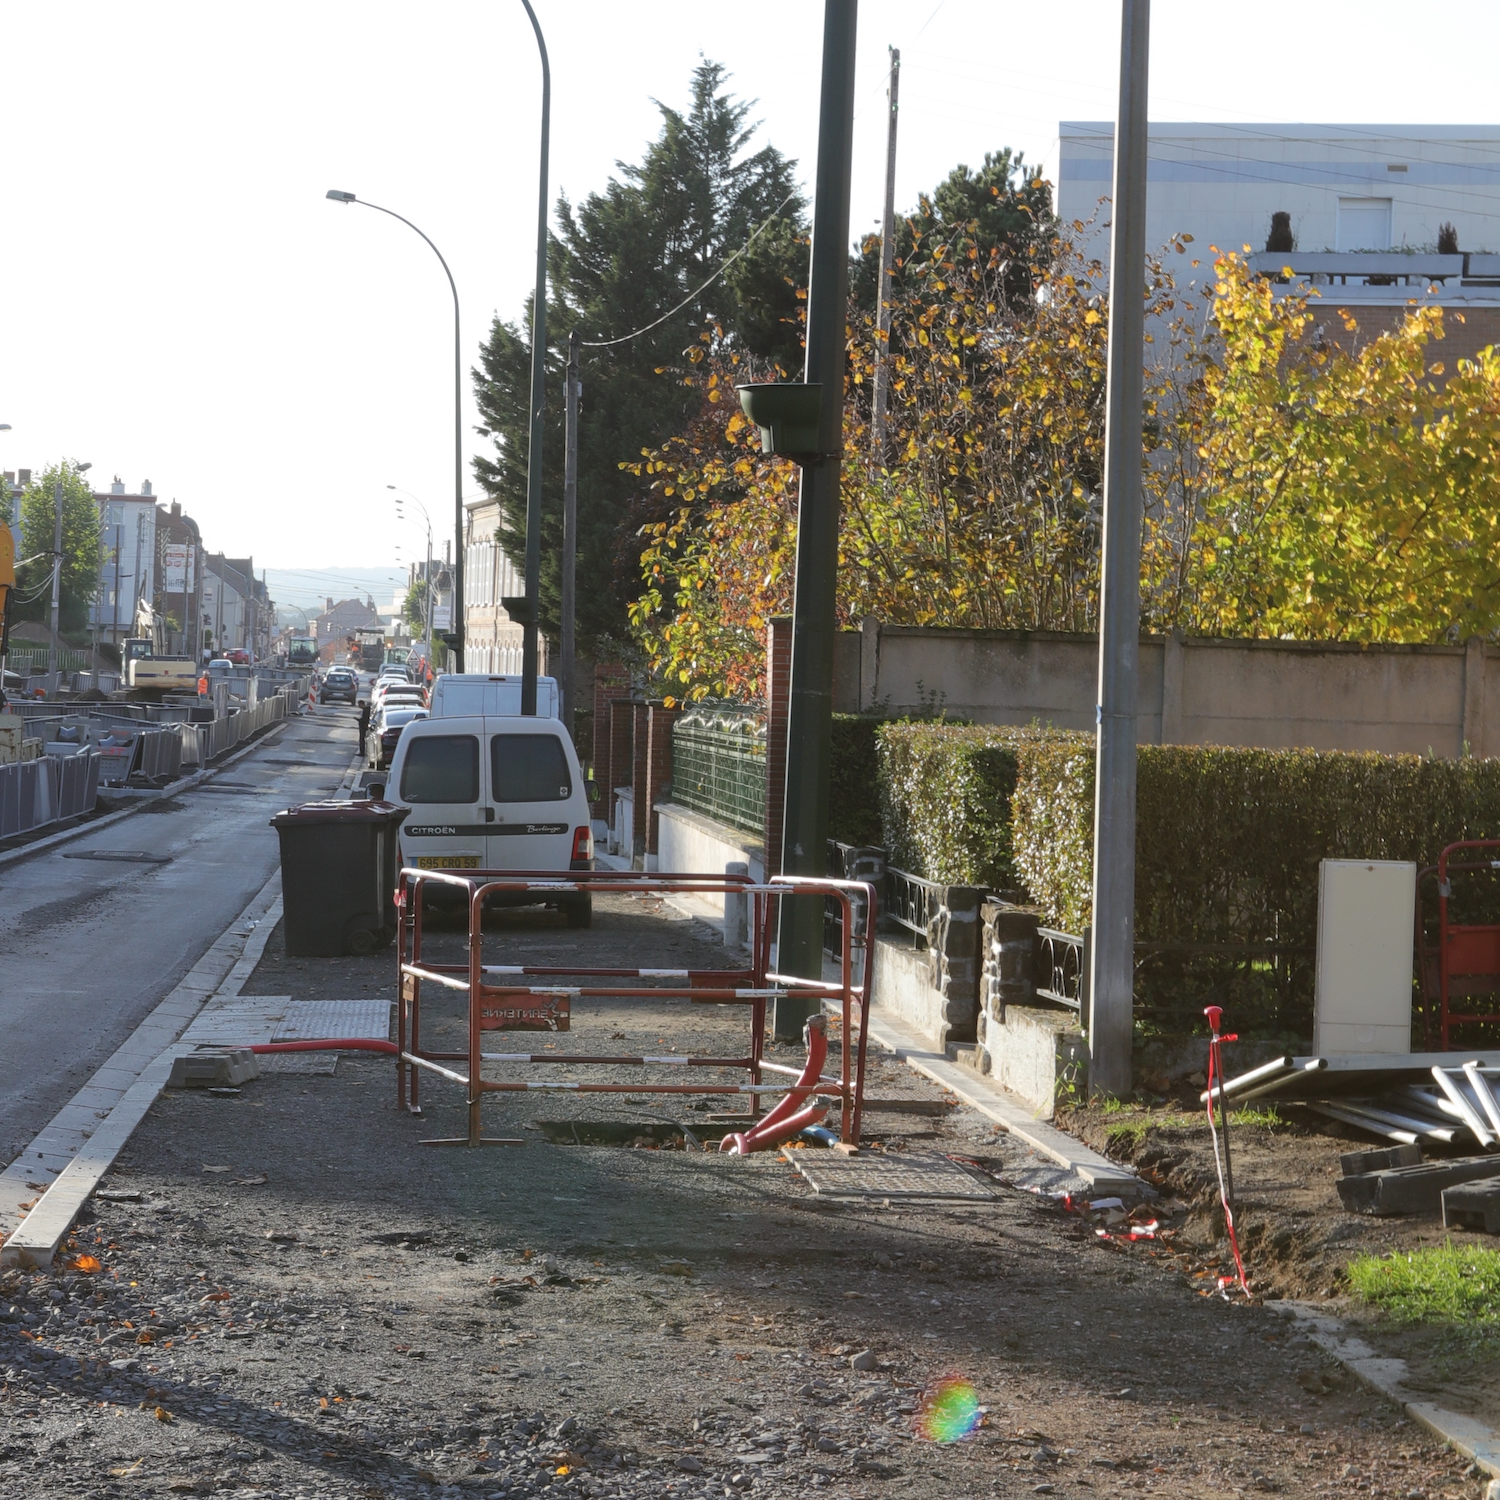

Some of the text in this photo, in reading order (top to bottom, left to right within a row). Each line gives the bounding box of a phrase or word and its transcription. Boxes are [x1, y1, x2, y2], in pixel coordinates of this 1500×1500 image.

[411, 824, 562, 835] CITROËN Berlingo
[419, 858, 439, 869] 695
[464, 858, 477, 869] 59
